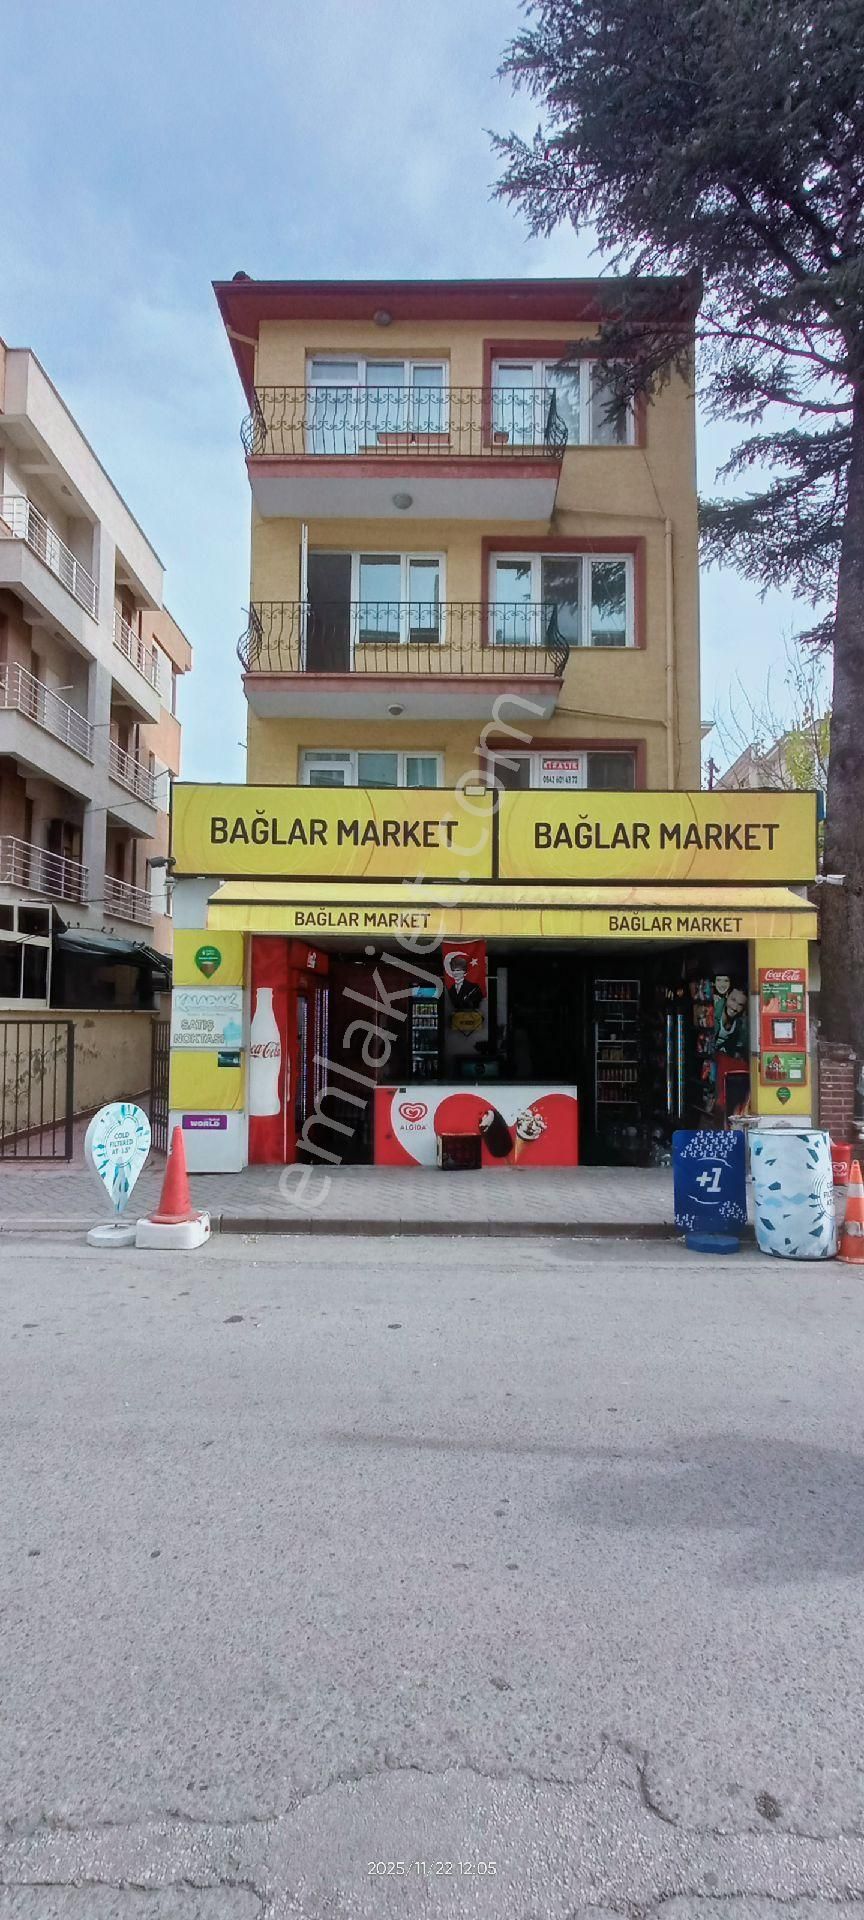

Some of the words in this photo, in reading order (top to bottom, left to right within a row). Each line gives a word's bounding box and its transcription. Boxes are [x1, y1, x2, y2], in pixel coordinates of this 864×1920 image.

[210, 808, 327, 846] BAĞLAR
[337, 819, 459, 848] MARKET
[534, 813, 650, 849] BAĞLAR
[660, 822, 780, 851] MARKET
[294, 907, 359, 927] BAĞLAR
[364, 912, 430, 928] MARKET
[609, 911, 672, 931] BAĞLAR
[676, 917, 742, 932] MARKET
[765, 969, 800, 981] Coca-Cola
[180, 1019, 215, 1032] SATIŞ
[114, 1131, 130, 1140] COLD
[696, 1167, 722, 1193] +1
